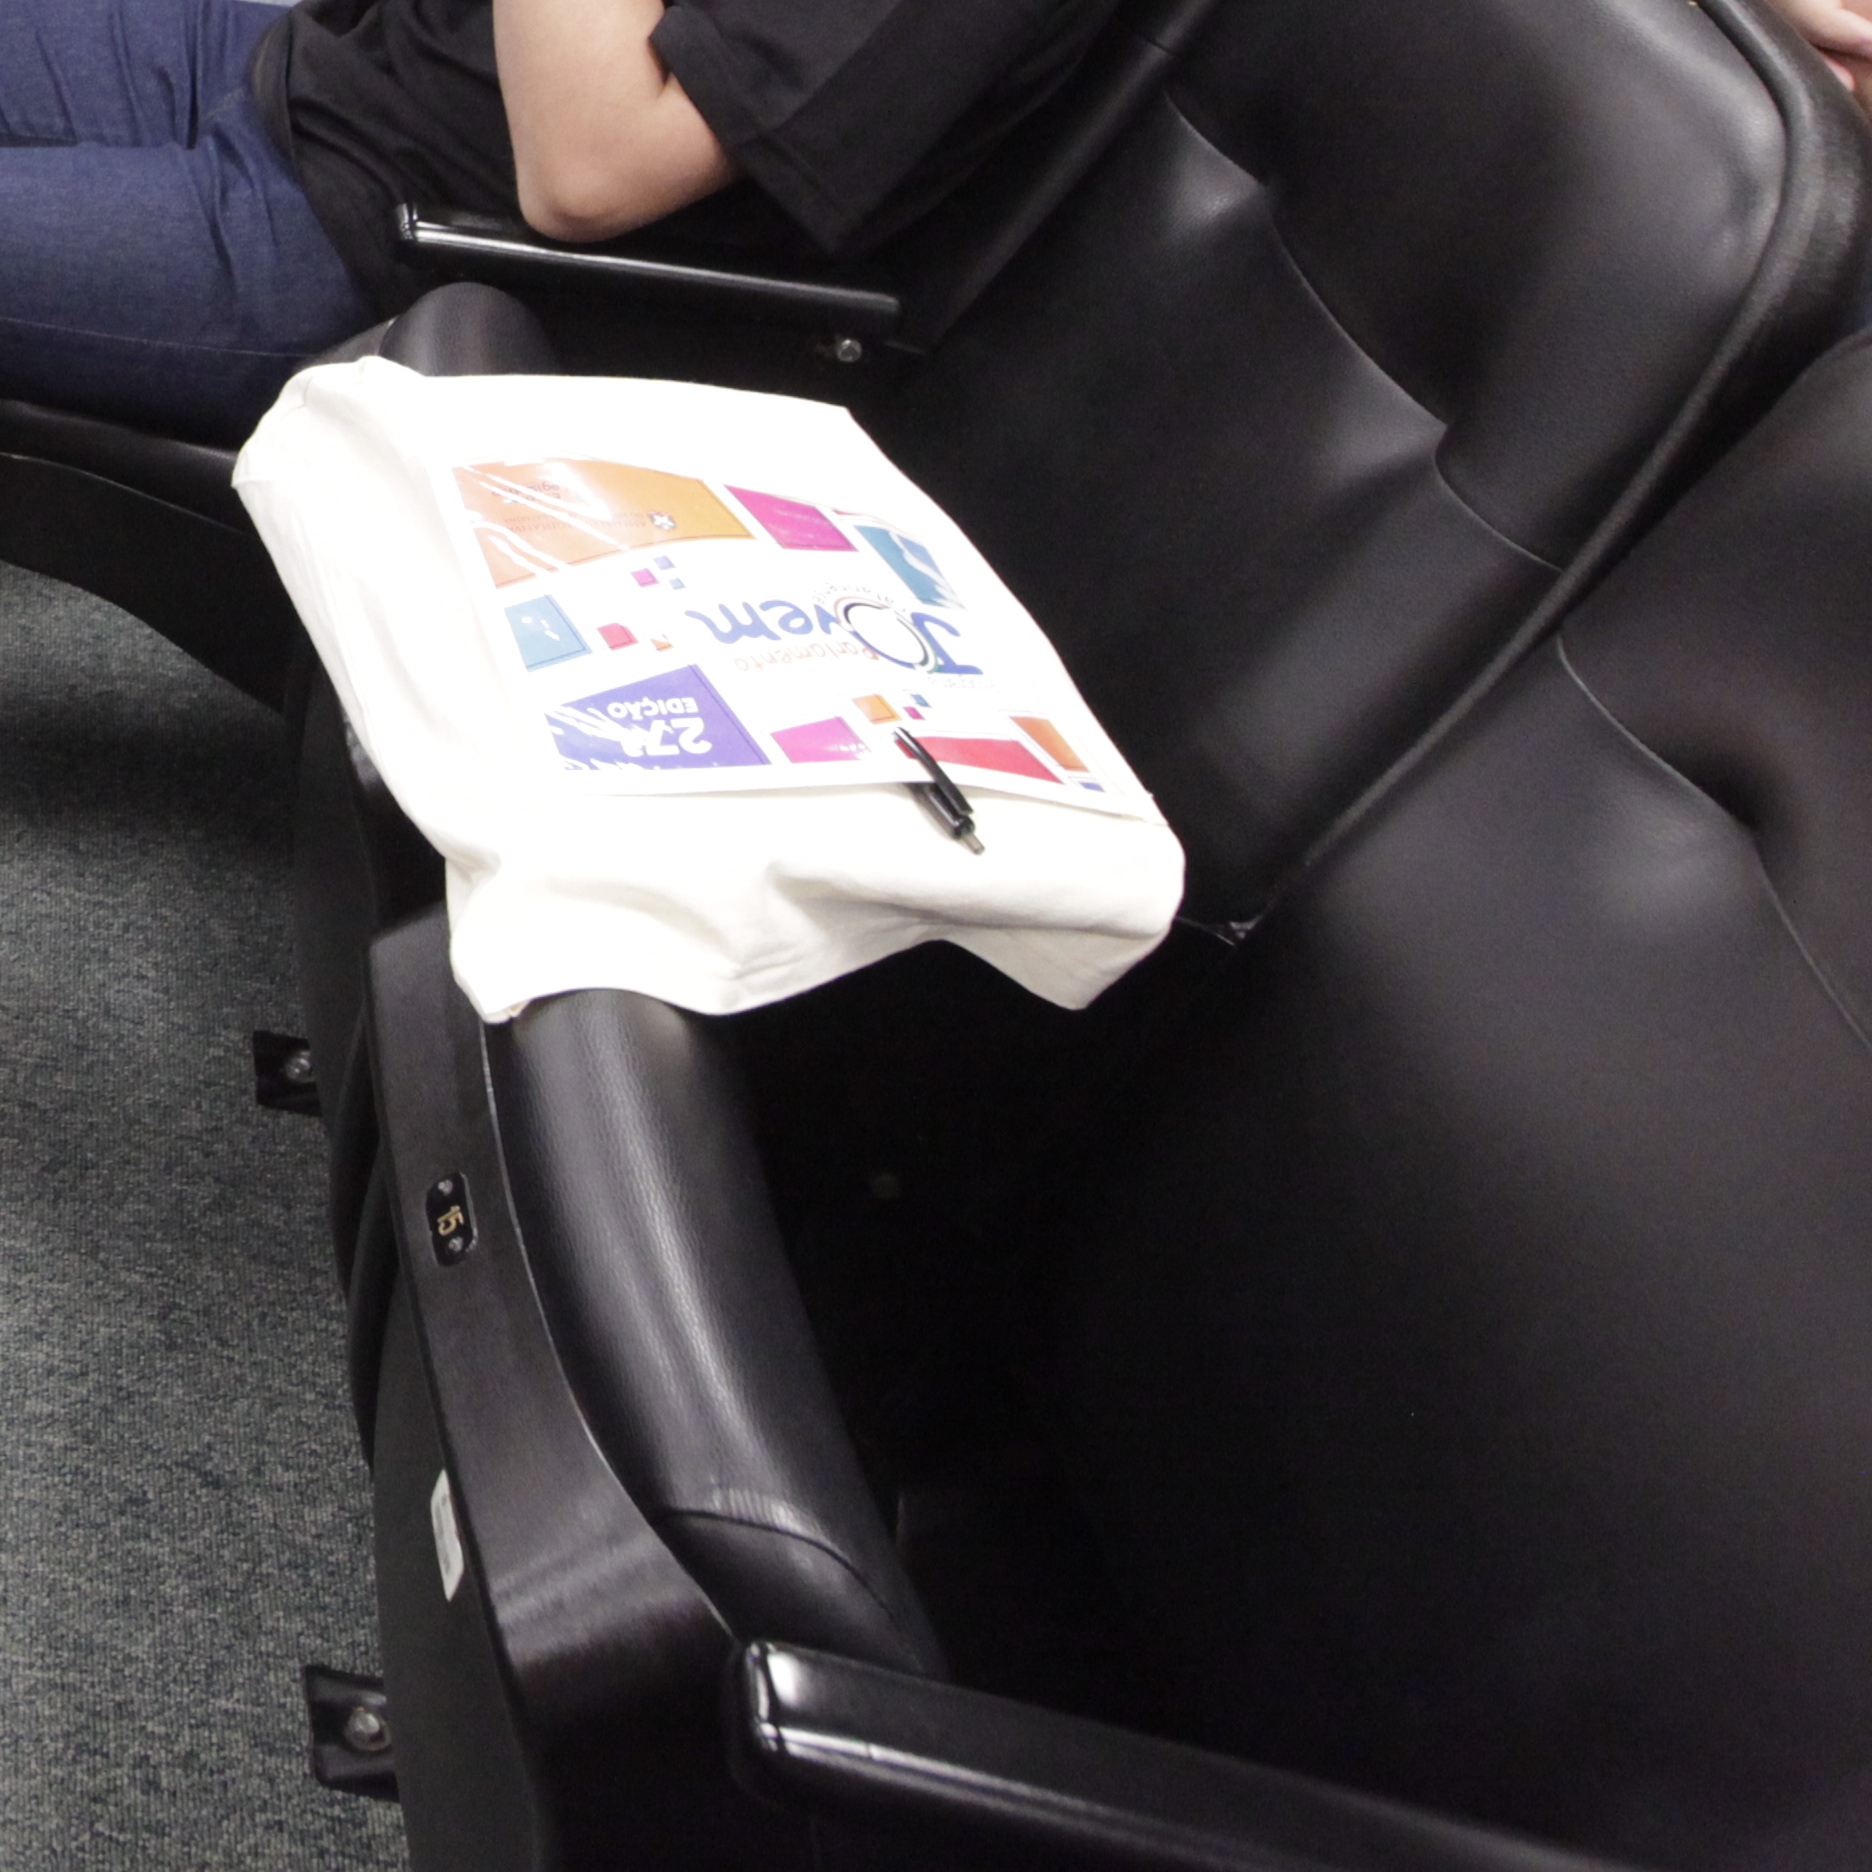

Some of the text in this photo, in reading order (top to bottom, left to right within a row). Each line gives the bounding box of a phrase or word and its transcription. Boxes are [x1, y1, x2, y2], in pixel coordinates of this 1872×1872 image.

[734, 640, 880, 672] Parlamento
[606, 696, 700, 720] EDIÇÃO
[437, 1205, 464, 1236] 15
